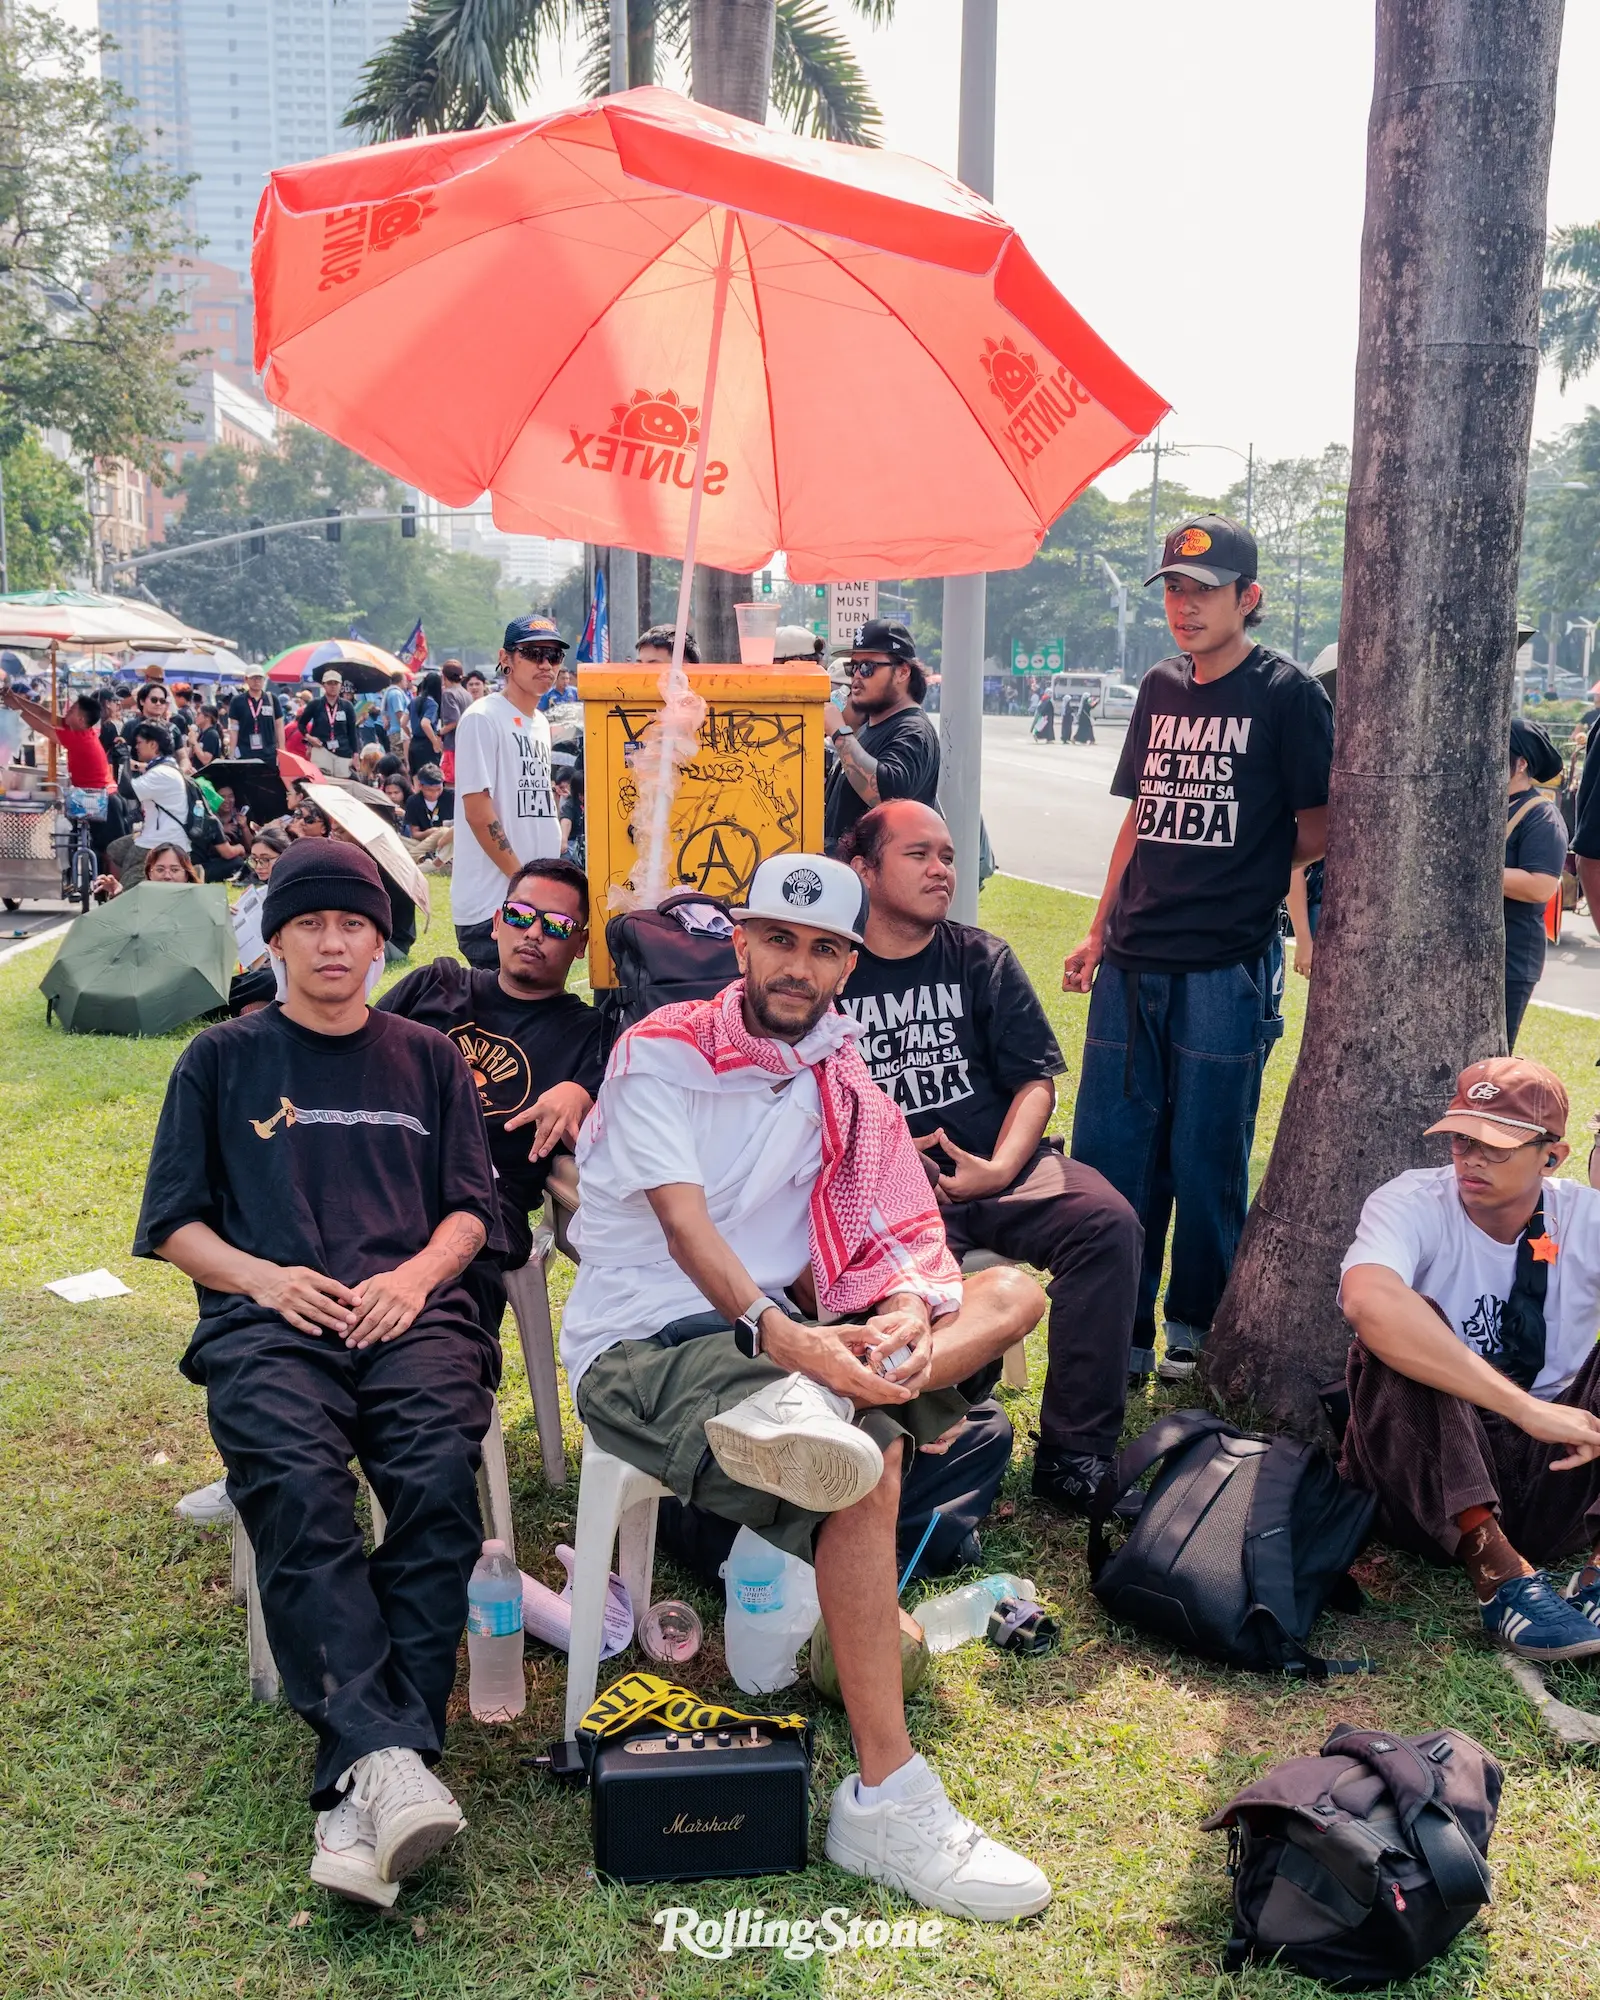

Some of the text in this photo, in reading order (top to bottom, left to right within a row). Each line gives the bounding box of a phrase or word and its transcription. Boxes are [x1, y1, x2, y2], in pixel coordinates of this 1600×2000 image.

[837, 581, 870, 591] LANE
[836, 597, 870, 607] MUST
[837, 612, 870, 622] TURN
[838, 627, 857, 638] LE
[1147, 714, 1253, 754] YAMAN
[1143, 752, 1234, 781] NG TAAS
[1139, 780, 1236, 800] GALING LAHAT SA
[785, 869, 822, 891] BOOMBAP
[788, 892, 811, 906] PINAS
[854, 1022, 957, 1062] NG TAAS
[870, 1045, 963, 1079] LING LAHAT SA
[662, 1813, 746, 1835] Marshall
